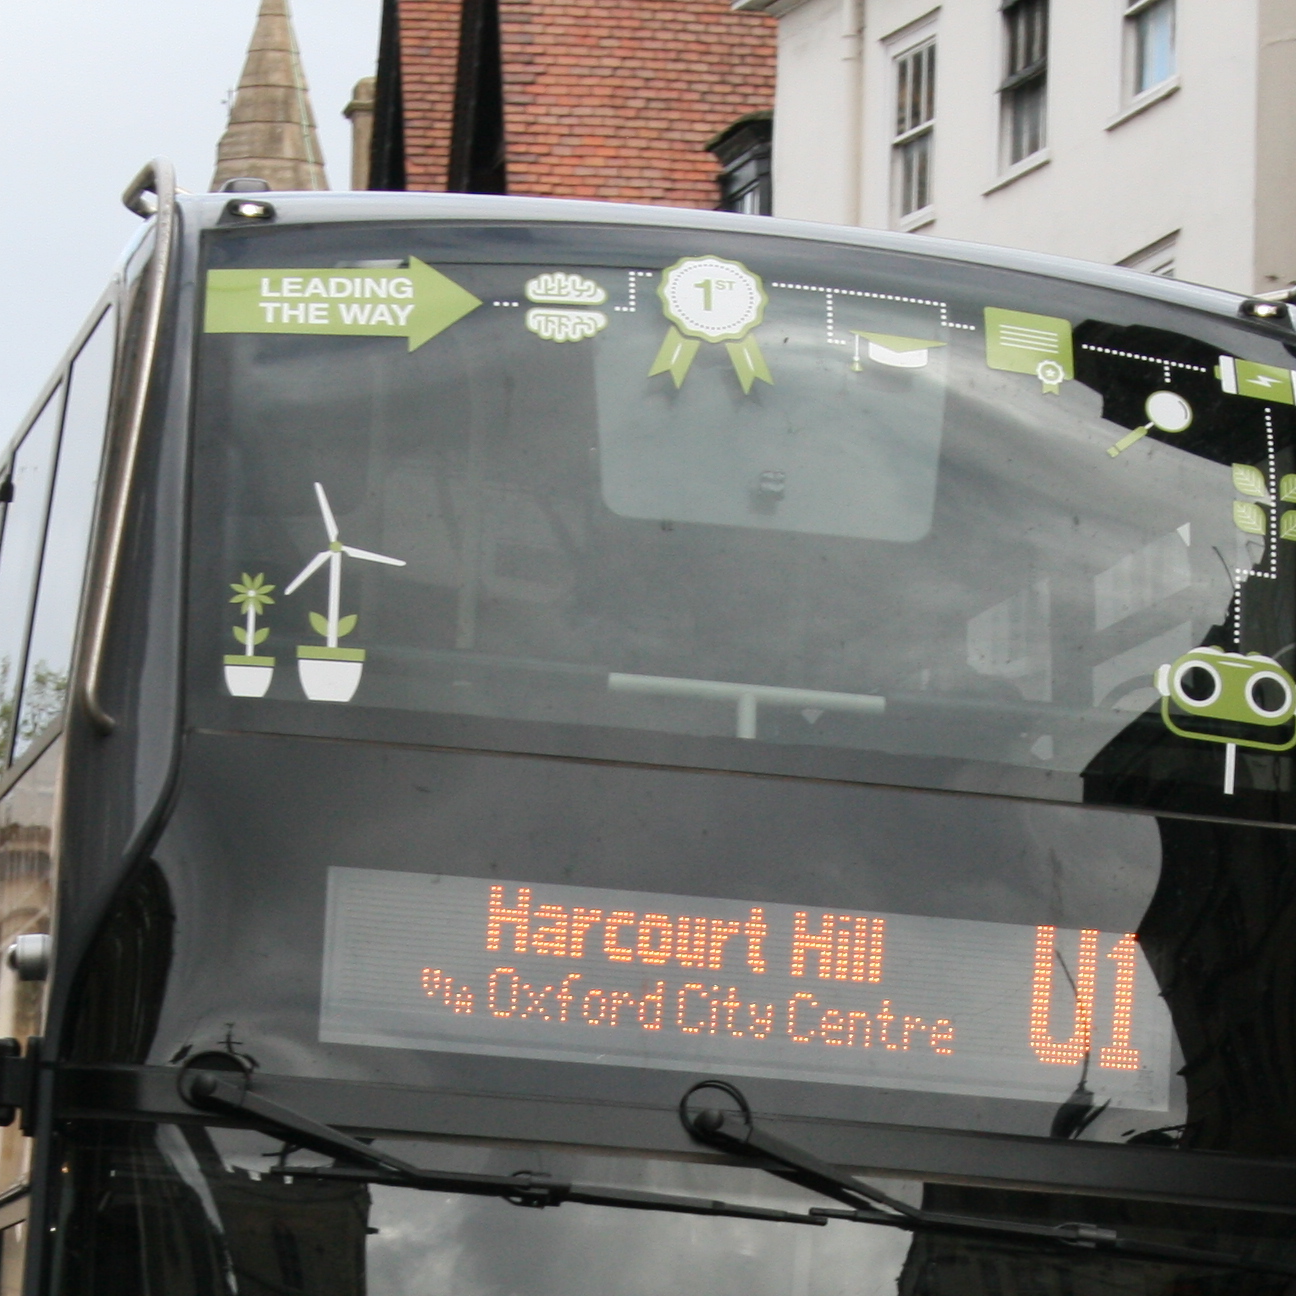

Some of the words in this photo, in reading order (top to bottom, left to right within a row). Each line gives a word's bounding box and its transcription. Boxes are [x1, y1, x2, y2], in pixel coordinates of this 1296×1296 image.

[259, 277, 414, 299] LEADING
[259, 302, 331, 324] THE
[338, 302, 414, 327] WAY
[485, 884, 768, 975] Harcourt
[790, 910, 885, 984] Hill
[488, 967, 666, 1031] Oxford
[676, 984, 774, 1040] City
[786, 991, 956, 1057] Centre
